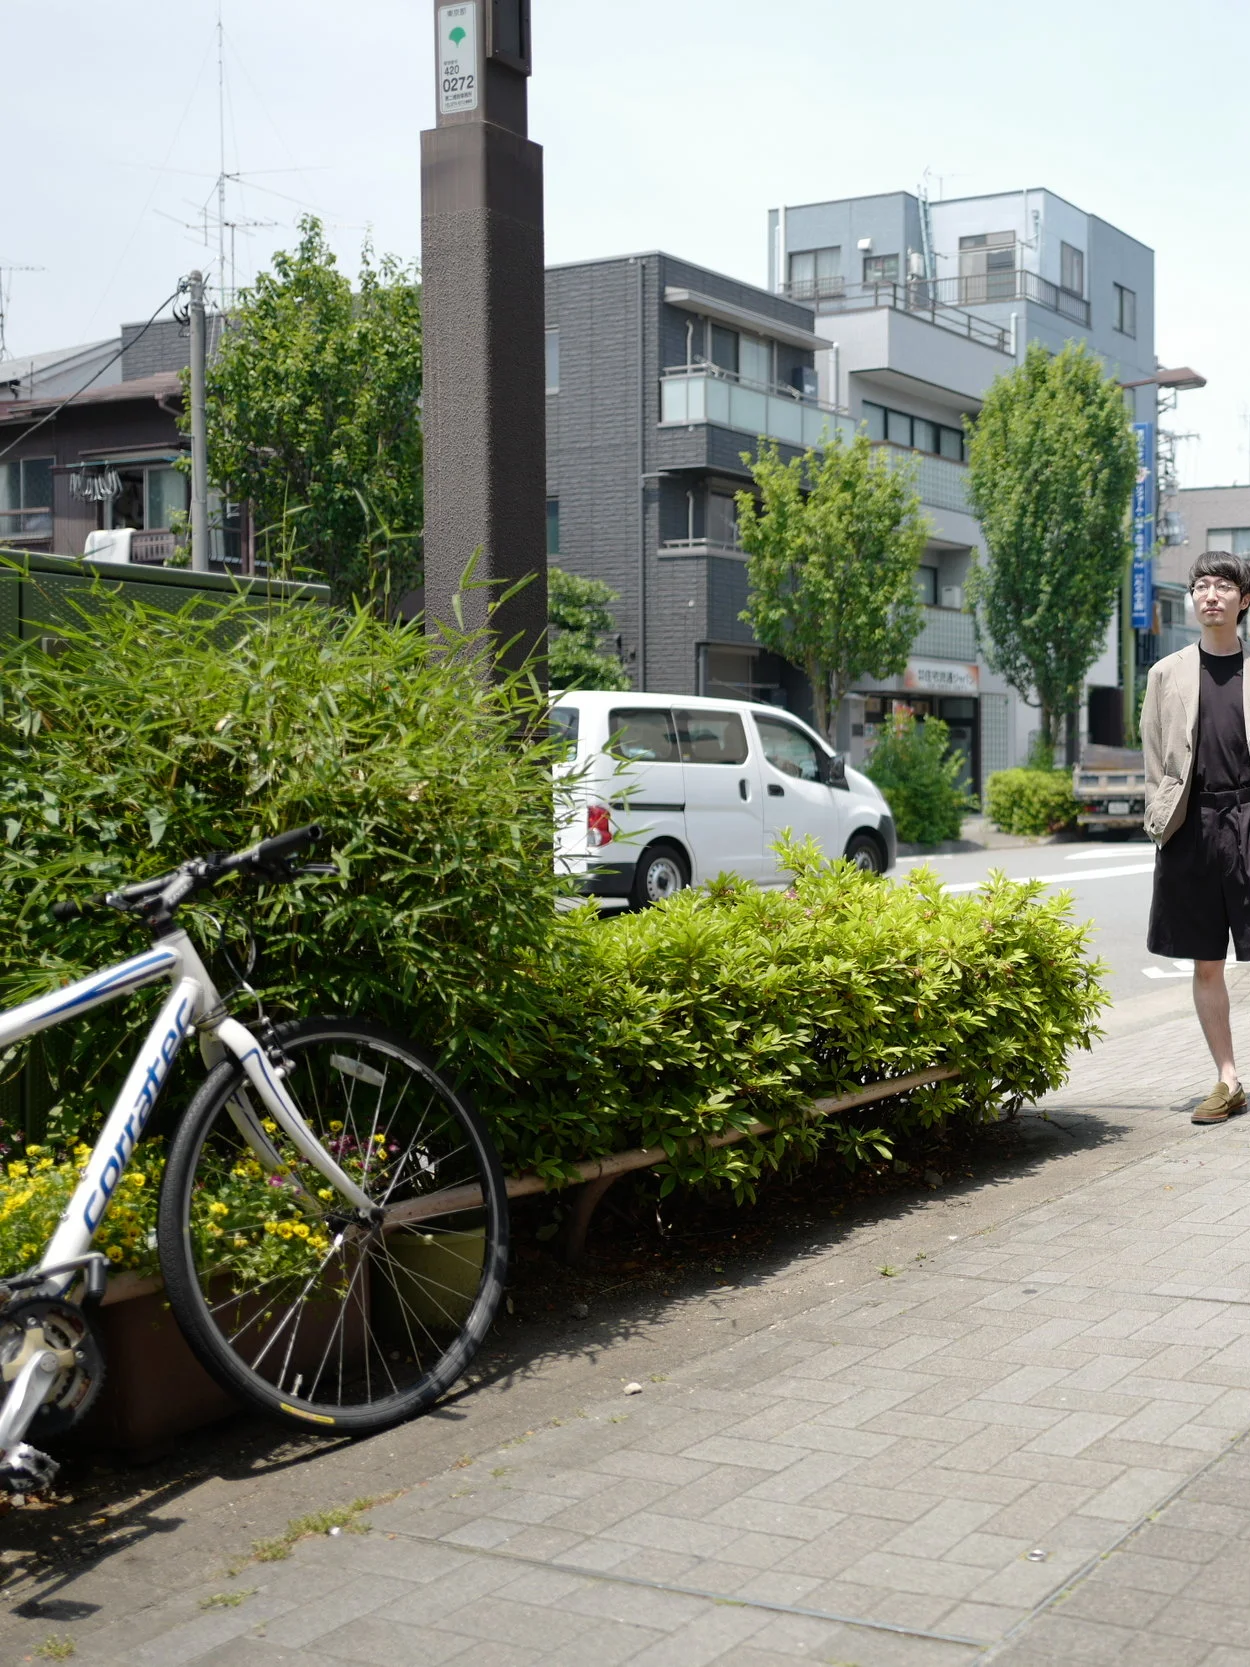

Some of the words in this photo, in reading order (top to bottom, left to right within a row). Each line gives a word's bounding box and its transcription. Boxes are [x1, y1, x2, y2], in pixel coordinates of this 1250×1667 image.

[444, 65, 459, 76] 420
[443, 75, 474, 92] 0272
[84, 997, 195, 1234] corratec
